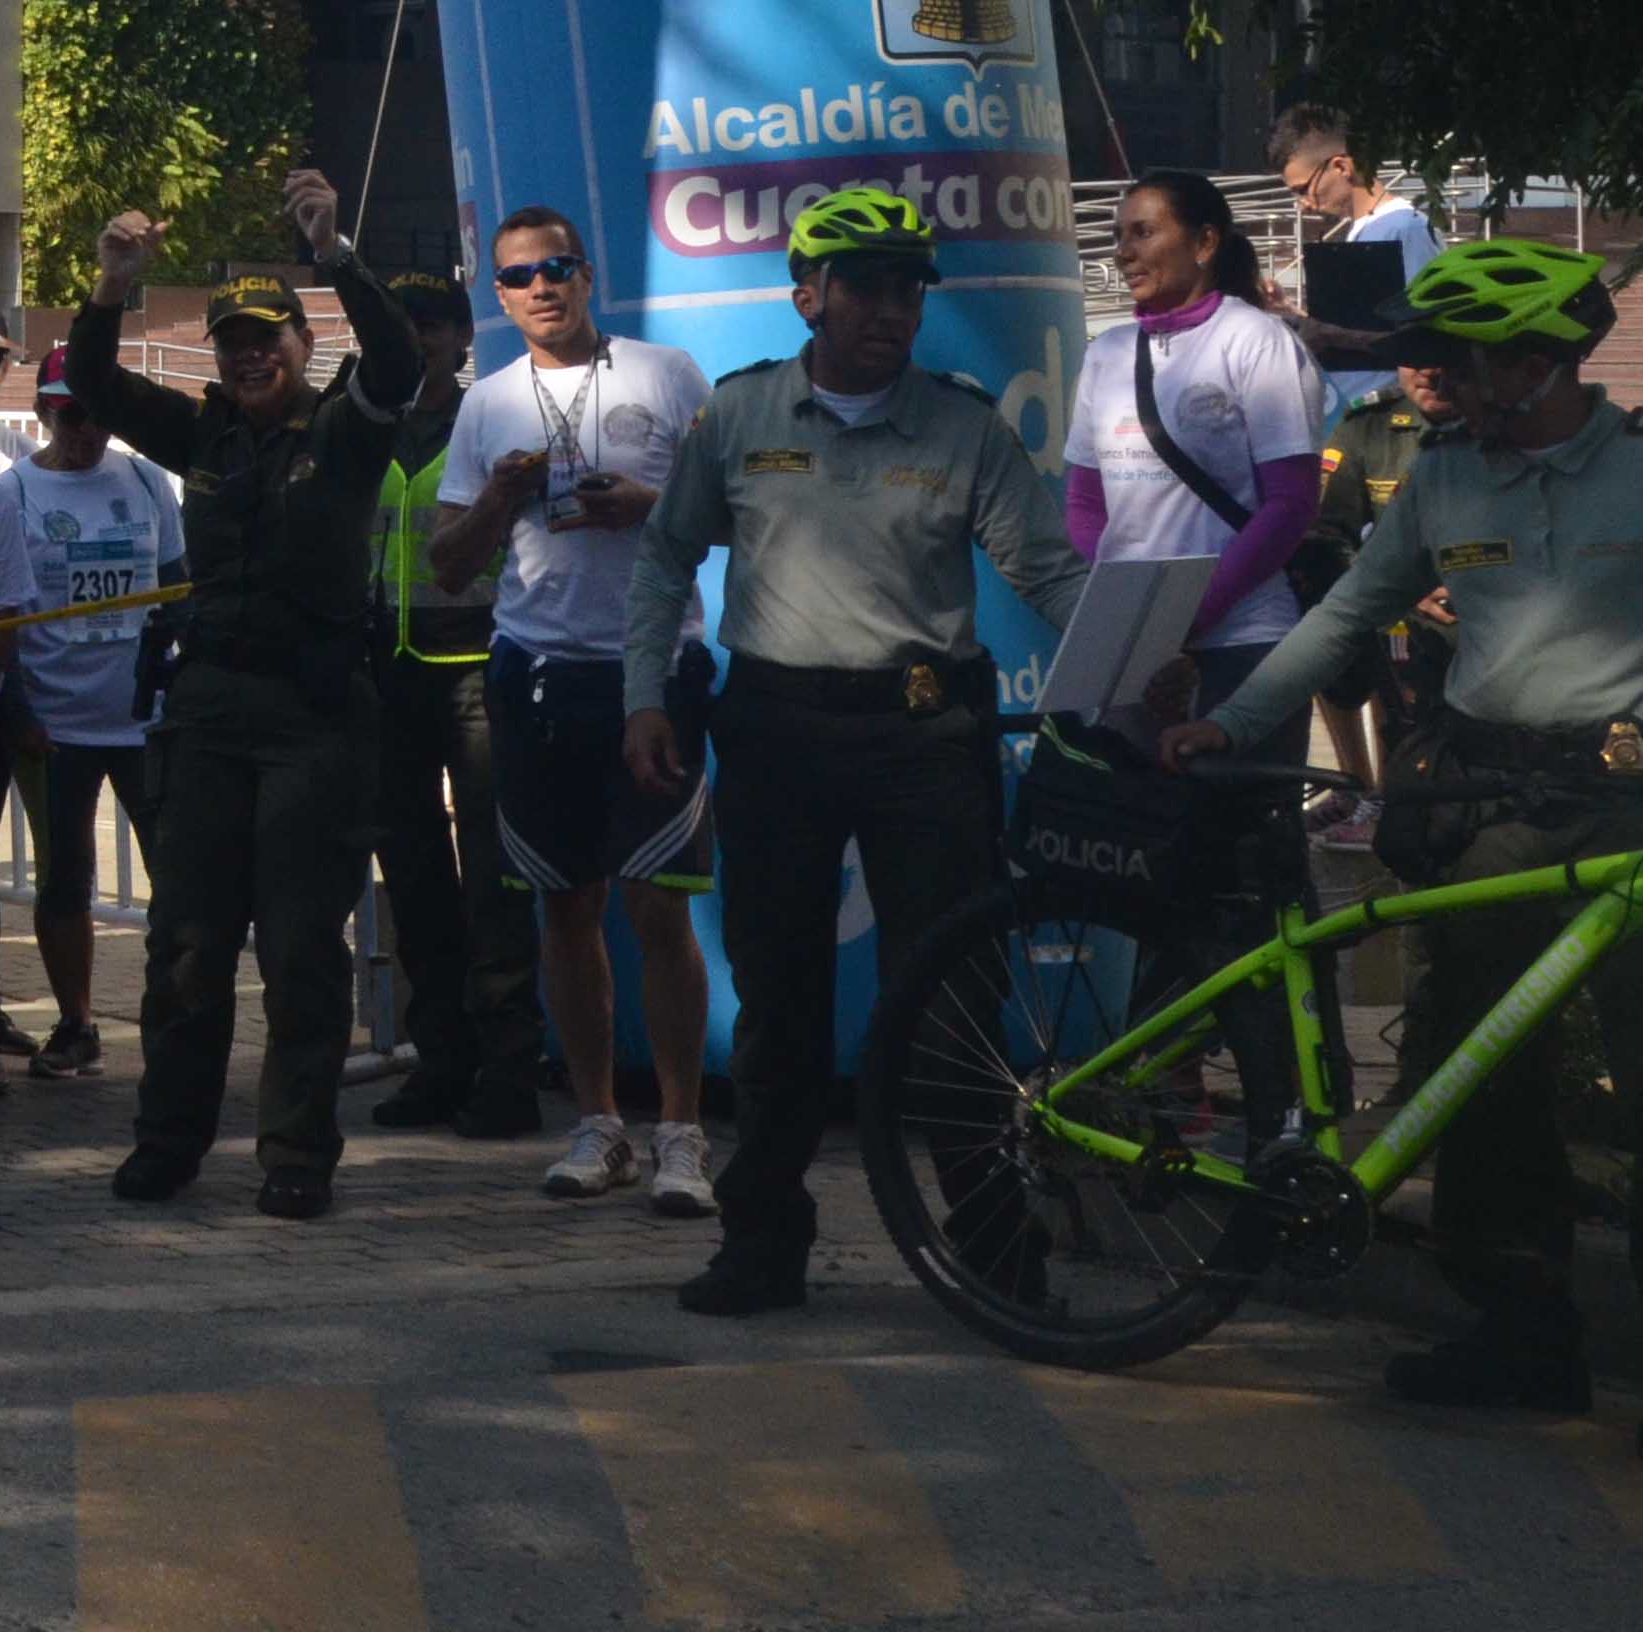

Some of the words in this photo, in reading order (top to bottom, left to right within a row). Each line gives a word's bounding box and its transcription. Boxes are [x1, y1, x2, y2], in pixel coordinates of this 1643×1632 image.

[643, 81, 928, 159] Alcaldía
[943, 80, 1012, 139] de
[664, 163, 982, 248] Cuta
[71, 569, 135, 603] 2307
[1472, 933, 1586, 1052] TURISMO
